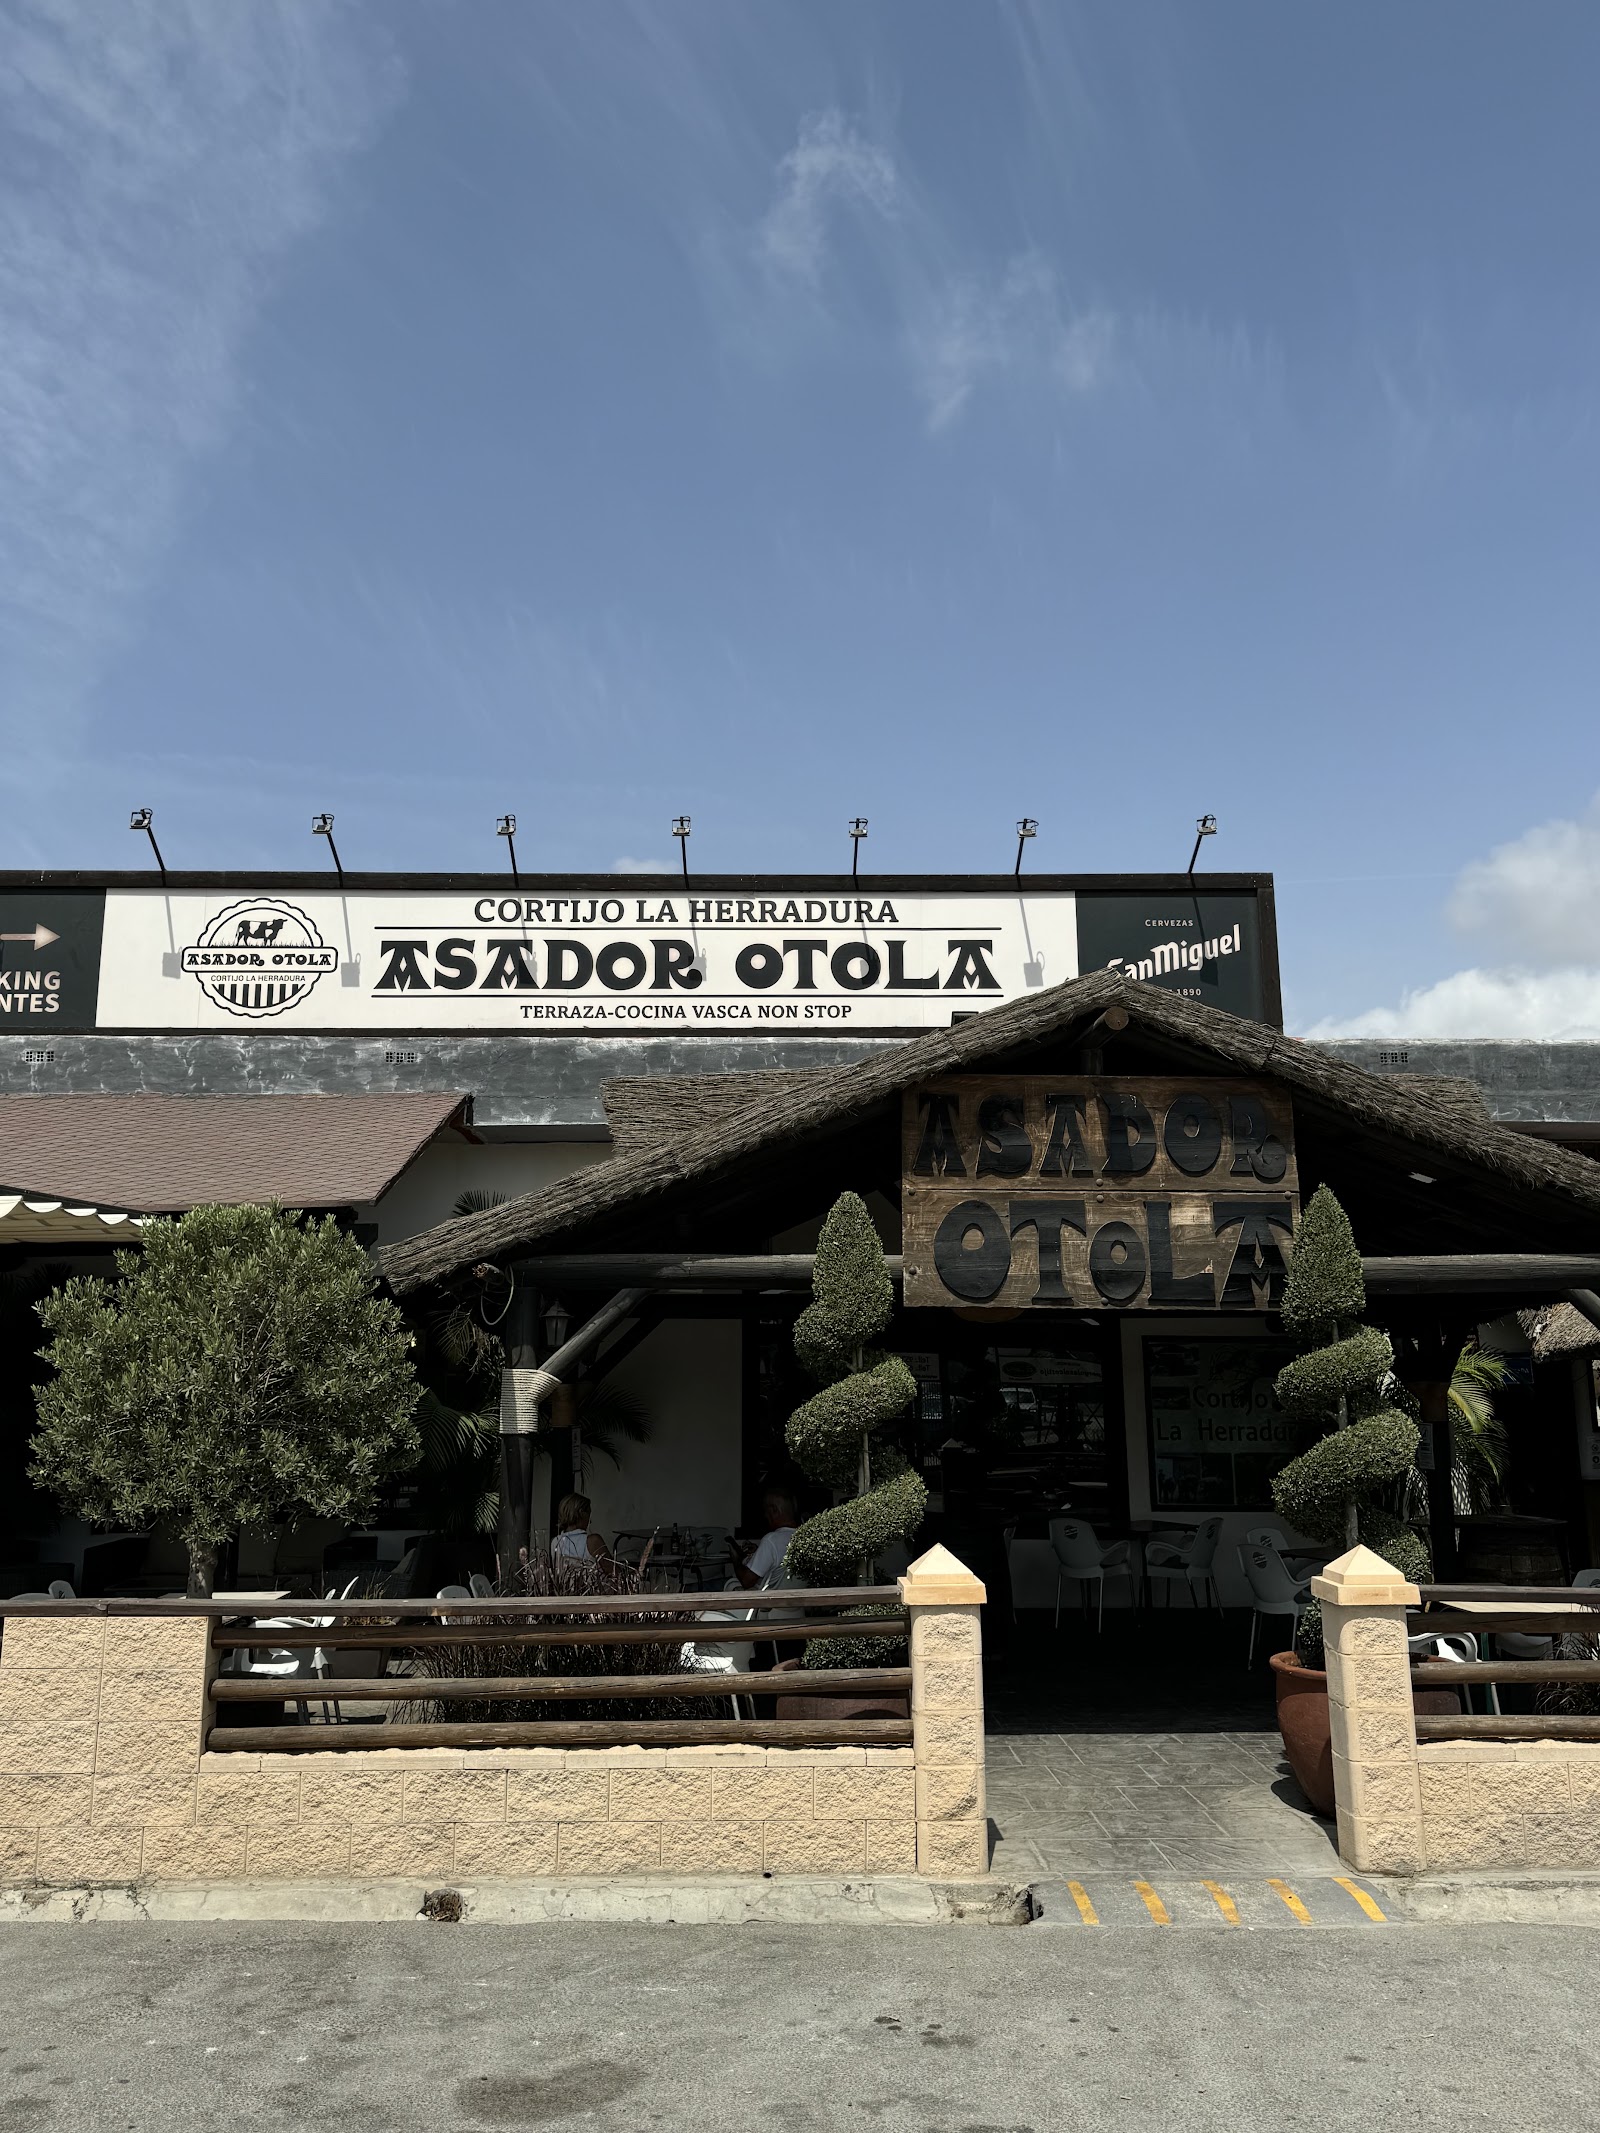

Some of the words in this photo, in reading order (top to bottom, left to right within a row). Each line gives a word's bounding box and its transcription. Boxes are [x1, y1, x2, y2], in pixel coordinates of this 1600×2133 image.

[474, 898, 625, 923] CORTIJO
[636, 899, 679, 923] LA
[689, 899, 900, 923] HERRADURA
[1145, 919, 1194, 927] CERVEZAS
[186, 953, 265, 967] ASADOR
[272, 953, 332, 966] OTOLA
[374, 937, 703, 992] ASADOR
[735, 939, 1002, 991] OTOLA
[0, 970, 61, 990] KING
[210, 974, 244, 982] CORTIJO
[246, 974, 256, 982] LA
[257, 974, 306, 982] HERRADURA
[0, 993, 60, 1013] NTES
[520, 1005, 687, 1019] TERRAZA-COCINA
[692, 1005, 752, 1019] VASCA
[758, 1005, 798, 1019] NON
[804, 1005, 852, 1019] STOP
[913, 1093, 1287, 1183] ASADOR
[933, 1199, 1293, 1306] OTOLA
[1156, 1418, 1182, 1441] La
[1198, 1418, 1299, 1441] Herradur
